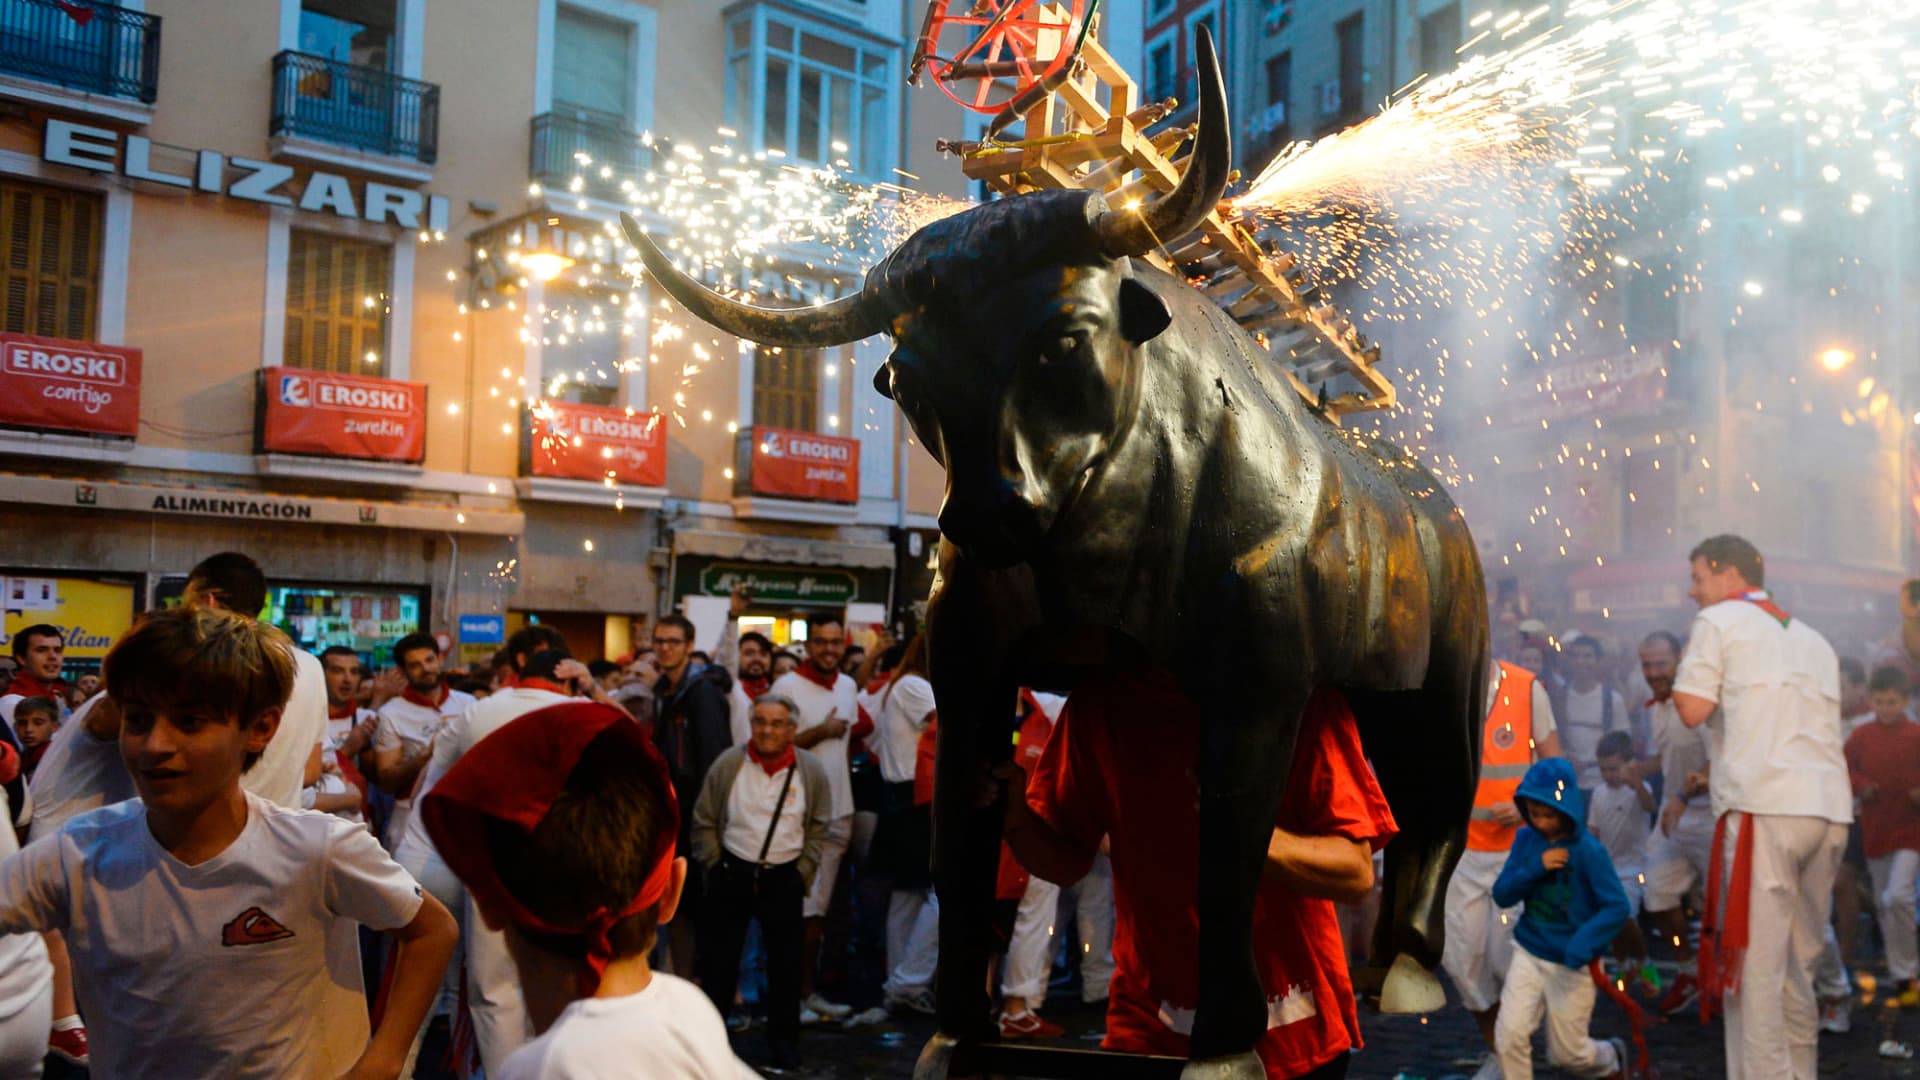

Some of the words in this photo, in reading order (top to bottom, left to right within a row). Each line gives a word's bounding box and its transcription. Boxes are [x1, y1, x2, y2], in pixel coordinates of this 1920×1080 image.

[45, 119, 449, 232] ELIZARI
[13, 349, 117, 379] EROSKI
[43, 383, 112, 414] contigo
[320, 384, 405, 411] EROSKI
[790, 439, 847, 461] EROSKI
[152, 494, 312, 519] ALIMENTACIÓN
